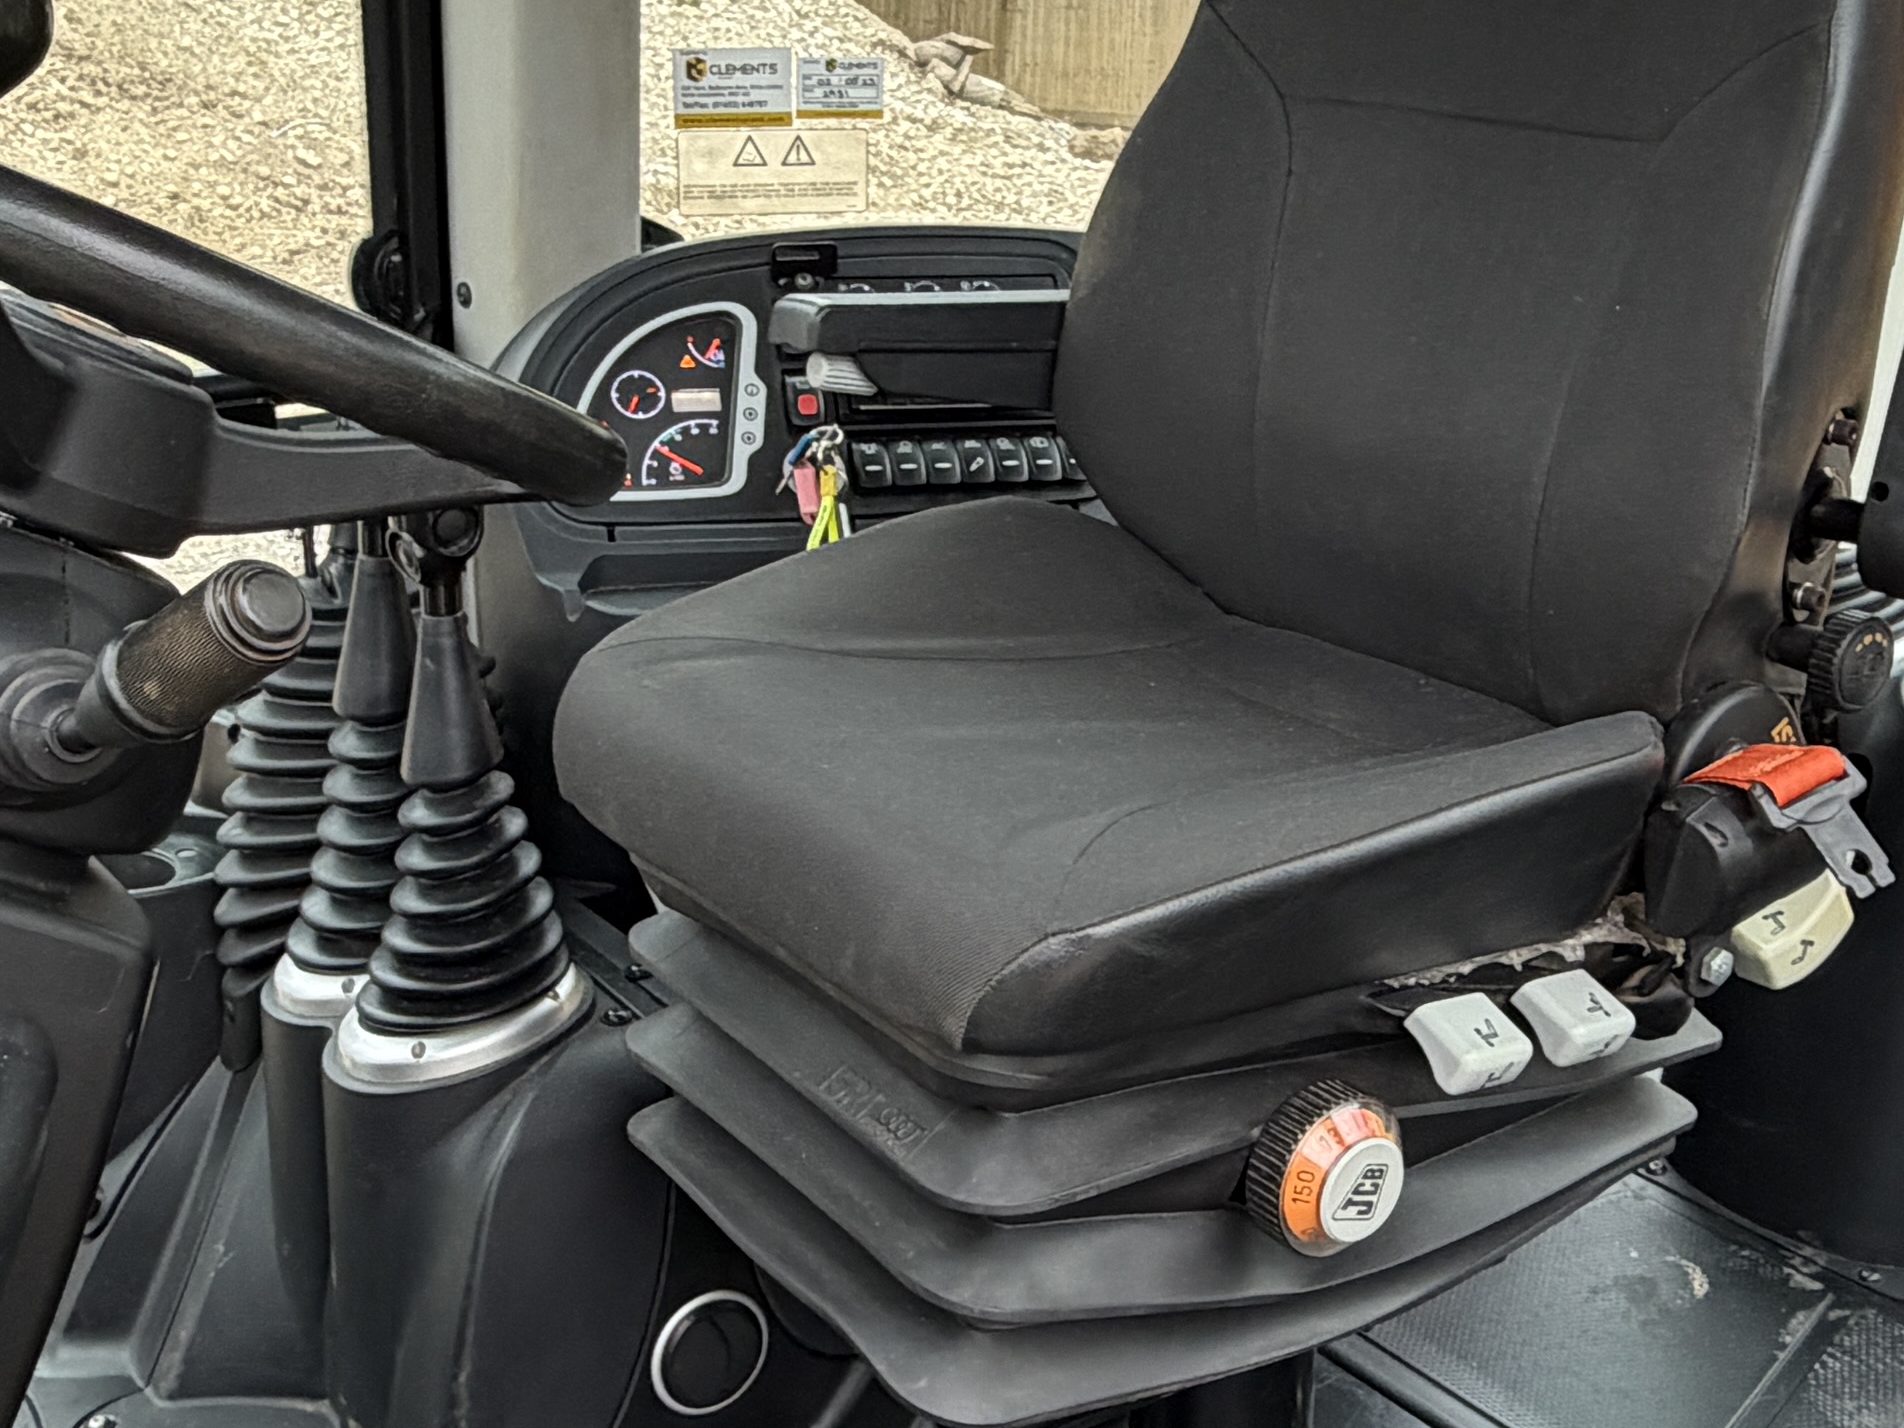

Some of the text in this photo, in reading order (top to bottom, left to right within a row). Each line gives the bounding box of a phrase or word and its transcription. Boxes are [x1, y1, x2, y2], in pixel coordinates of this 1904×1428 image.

[709, 62, 778, 75] CLEMENTS
[1292, 1170, 1316, 1205] 150
[1340, 1167, 1385, 1217] JCB
